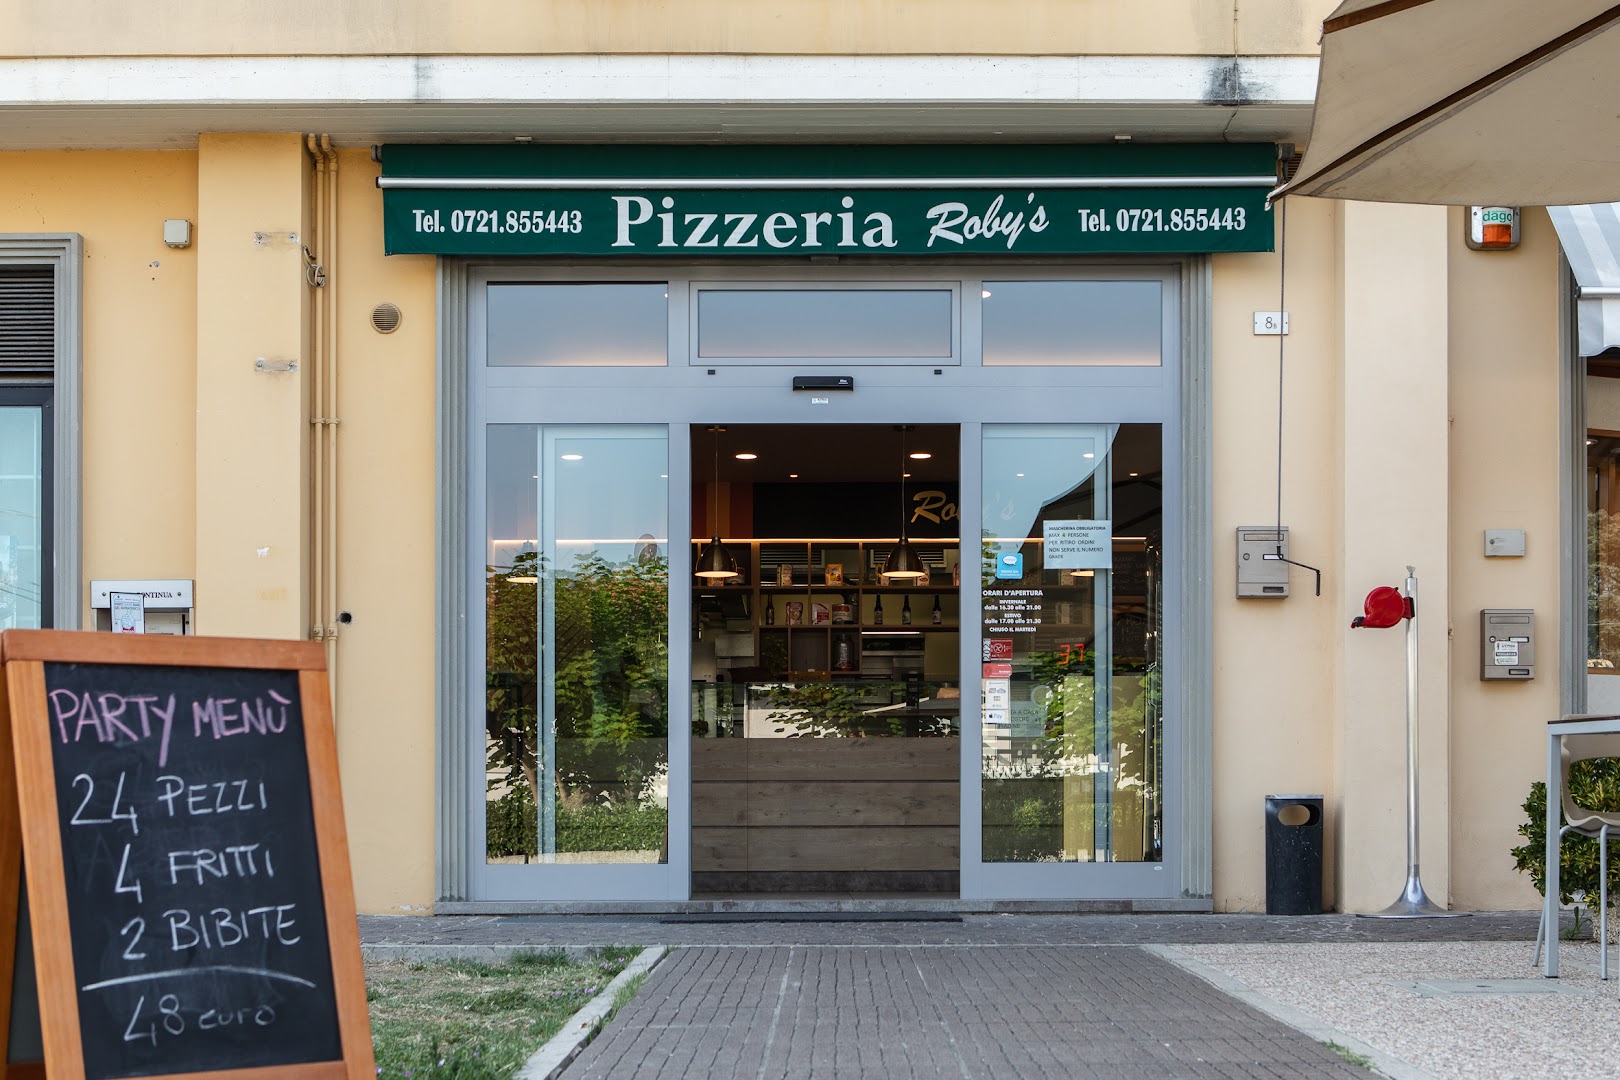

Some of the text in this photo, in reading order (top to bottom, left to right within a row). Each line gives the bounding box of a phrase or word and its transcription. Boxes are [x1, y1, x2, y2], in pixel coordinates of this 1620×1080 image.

[412, 192, 1247, 250] Tel. 0721.855443 Pizzeria Roby's Tel. 0721.855443
[1482, 210, 1513, 223] dago
[1058, 643, 1085, 665] 37
[48, 688, 292, 768] PARTY MENÙ
[70, 771, 268, 835] 24 PEZZI
[115, 843, 275, 904] 4 FRITTI
[121, 903, 301, 961] 2 BIBITE
[123, 994, 276, 1046] 48 euro
